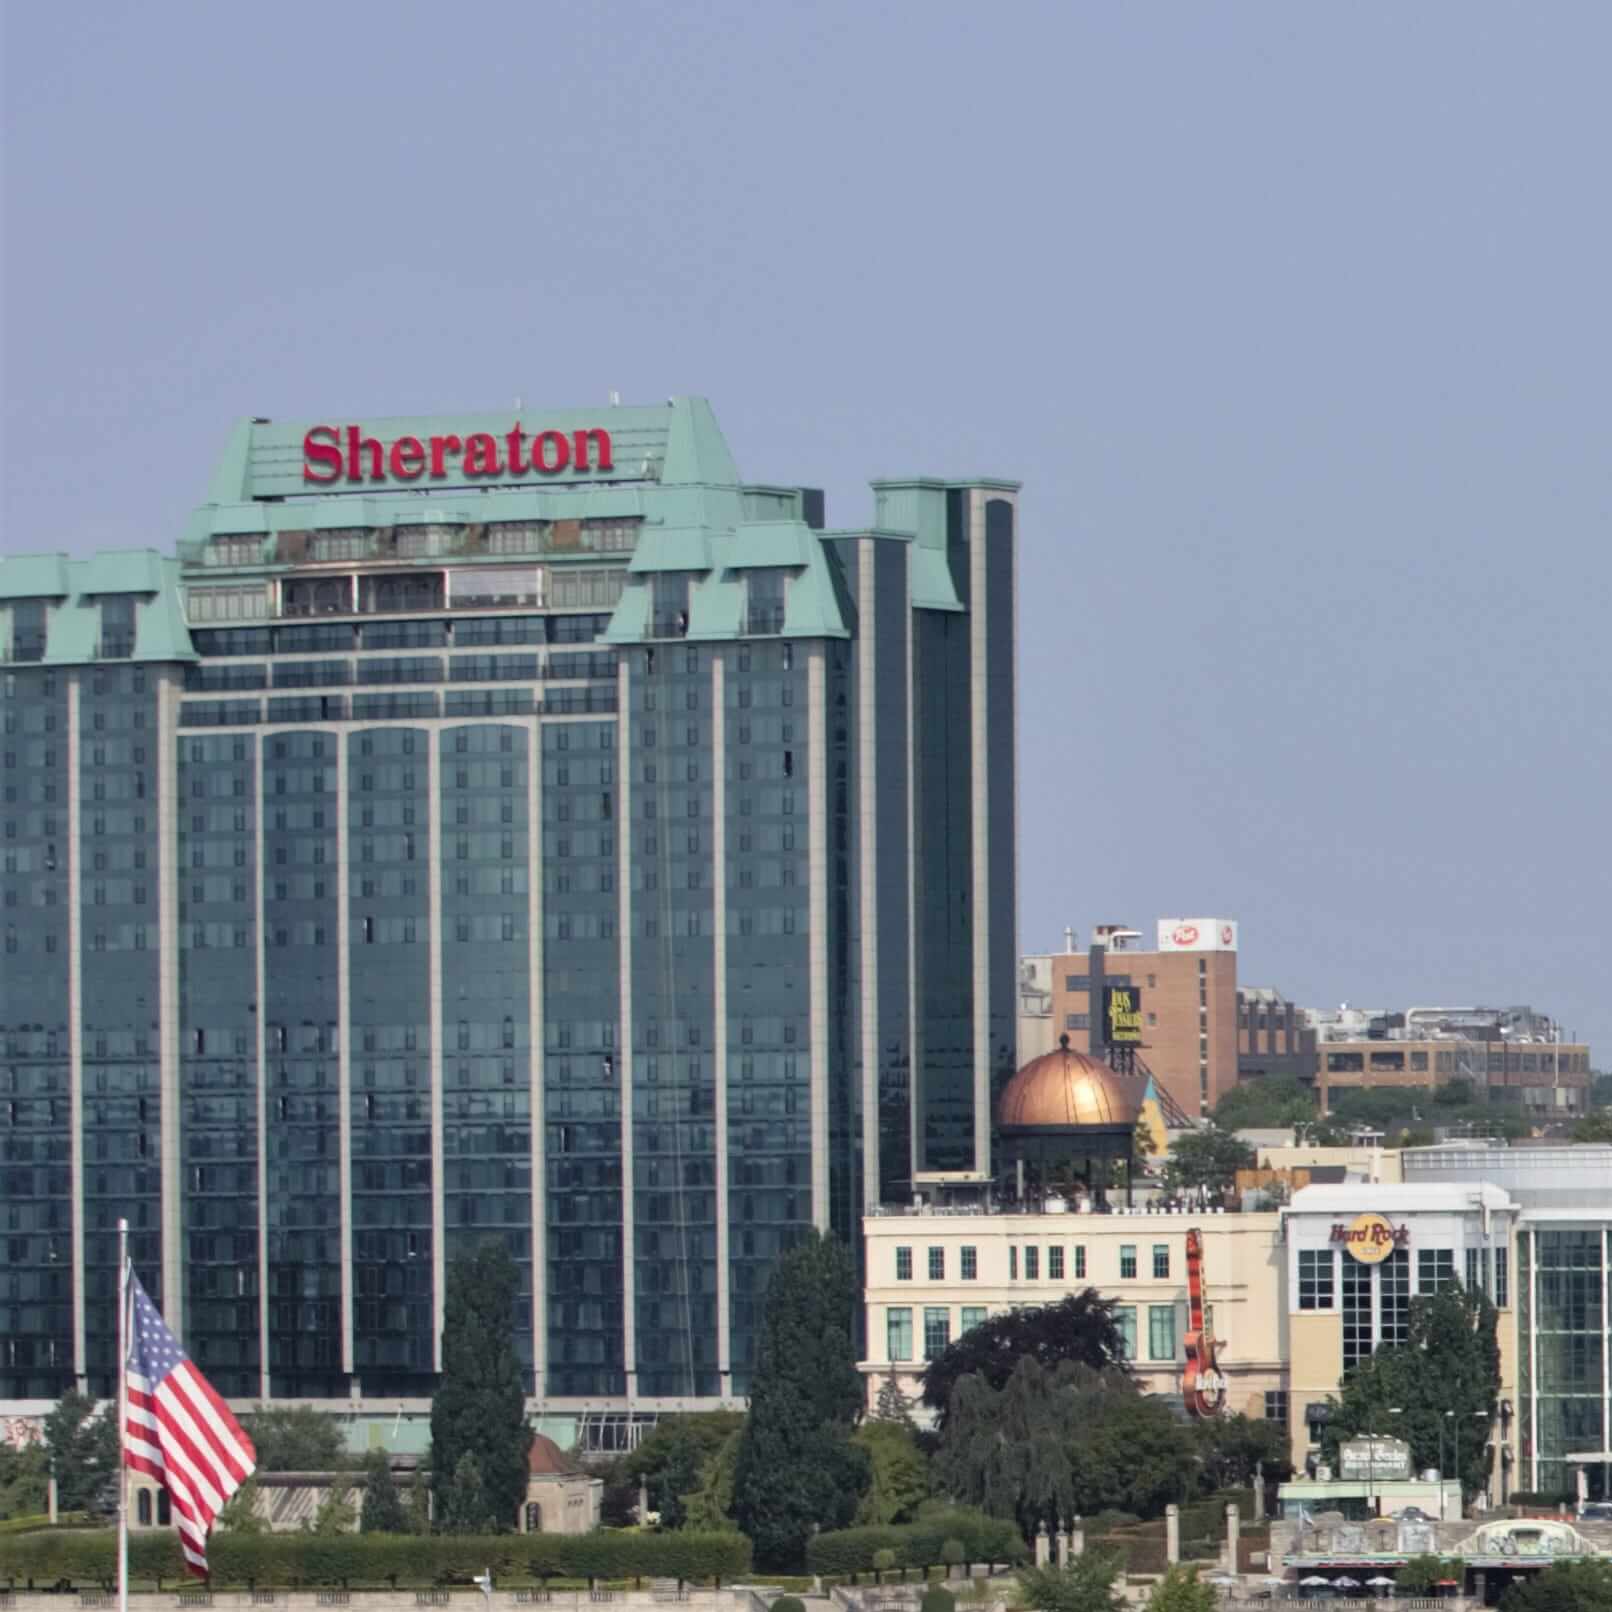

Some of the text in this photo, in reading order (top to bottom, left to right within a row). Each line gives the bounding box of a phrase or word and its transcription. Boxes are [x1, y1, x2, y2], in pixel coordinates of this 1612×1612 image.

[303, 421, 615, 484] Sheraton
[1329, 1223, 1409, 1246] Hard Rock
